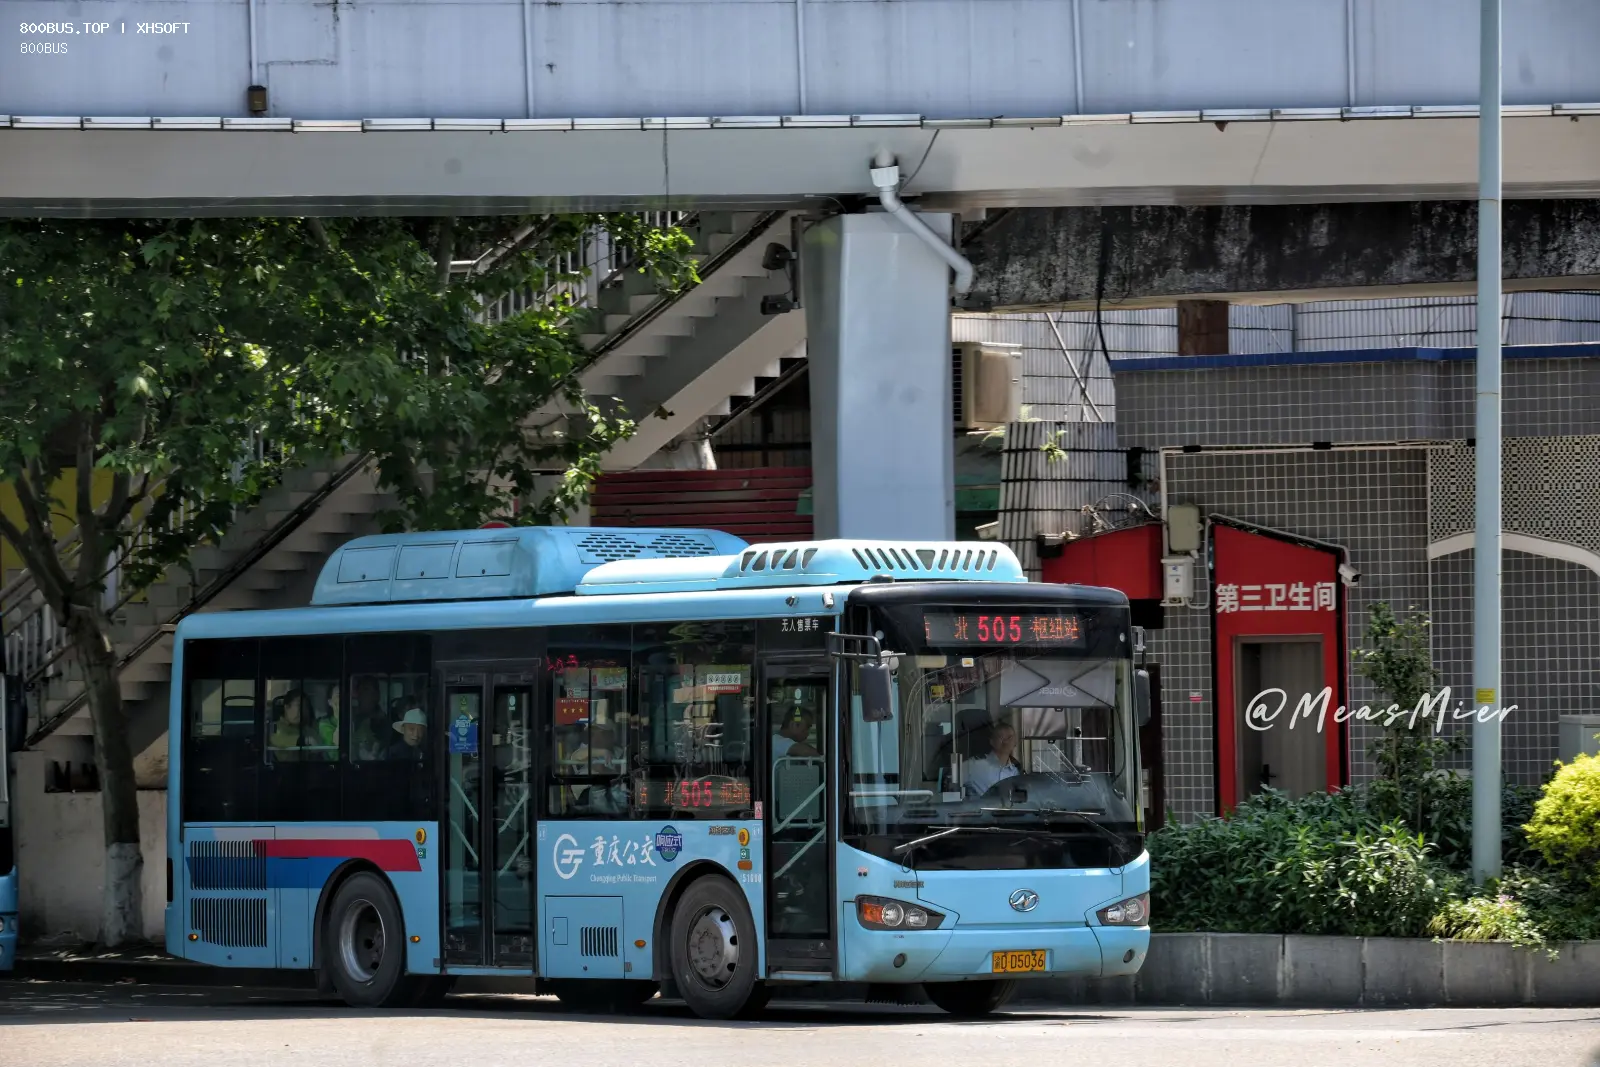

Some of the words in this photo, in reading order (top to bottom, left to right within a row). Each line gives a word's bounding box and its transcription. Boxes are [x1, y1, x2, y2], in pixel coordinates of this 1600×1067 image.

[1215, 581, 1337, 612] 第三卫生间
[781, 618, 819, 632] 无人售票车
[977, 615, 1021, 642] 505
[1030, 616, 1080, 641] 枢纽站
[681, 781, 713, 807] 505
[589, 835, 657, 867] 重庆公交
